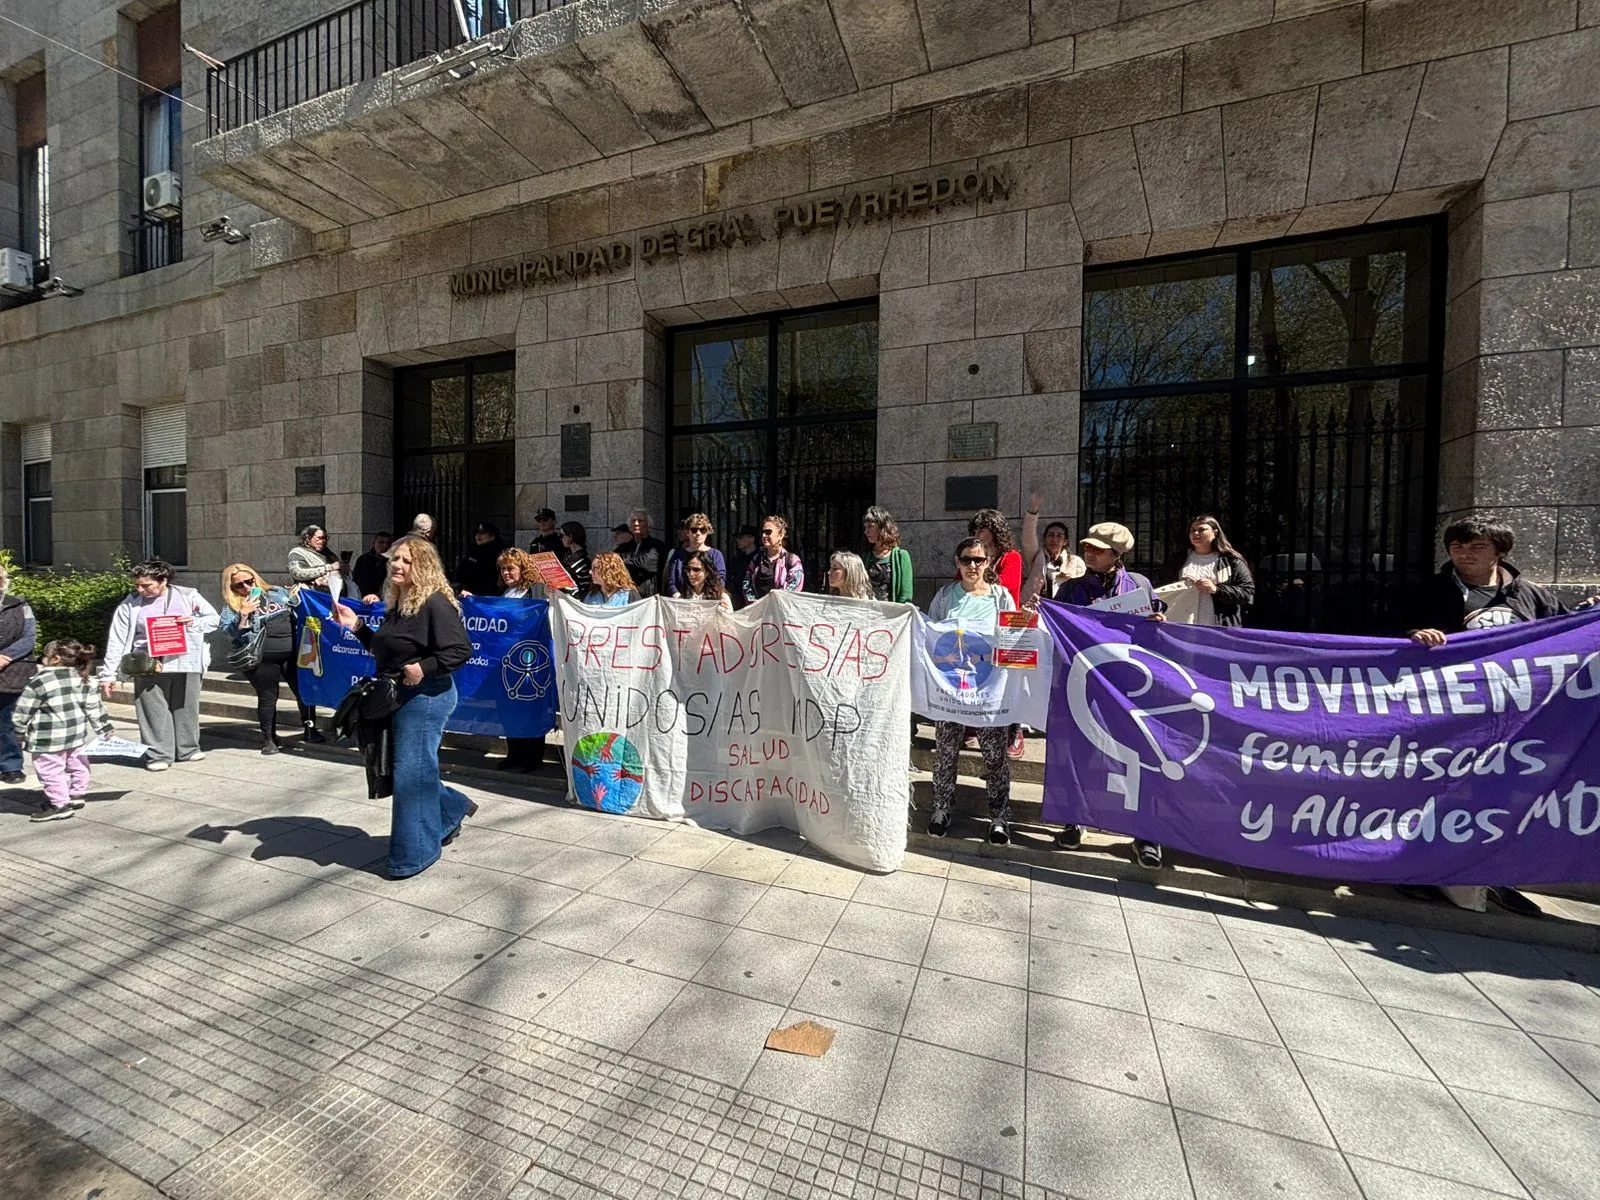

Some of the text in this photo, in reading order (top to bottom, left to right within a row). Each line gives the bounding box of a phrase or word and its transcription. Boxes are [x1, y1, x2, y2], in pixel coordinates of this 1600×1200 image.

[450, 242, 631, 296] MUNICIPALIDAD
[640, 230, 677, 259] DE
[773, 166, 1011, 229] PUEYRREDON
[1109, 603, 1122, 611] LEY
[1140, 605, 1151, 613] EN
[461, 616, 508, 633] ACIDAD
[728, 739, 790, 767] SALUD
[1238, 732, 1547, 781] femidiscas
[1240, 800, 1274, 842] y
[1291, 794, 1510, 844] Aliades
